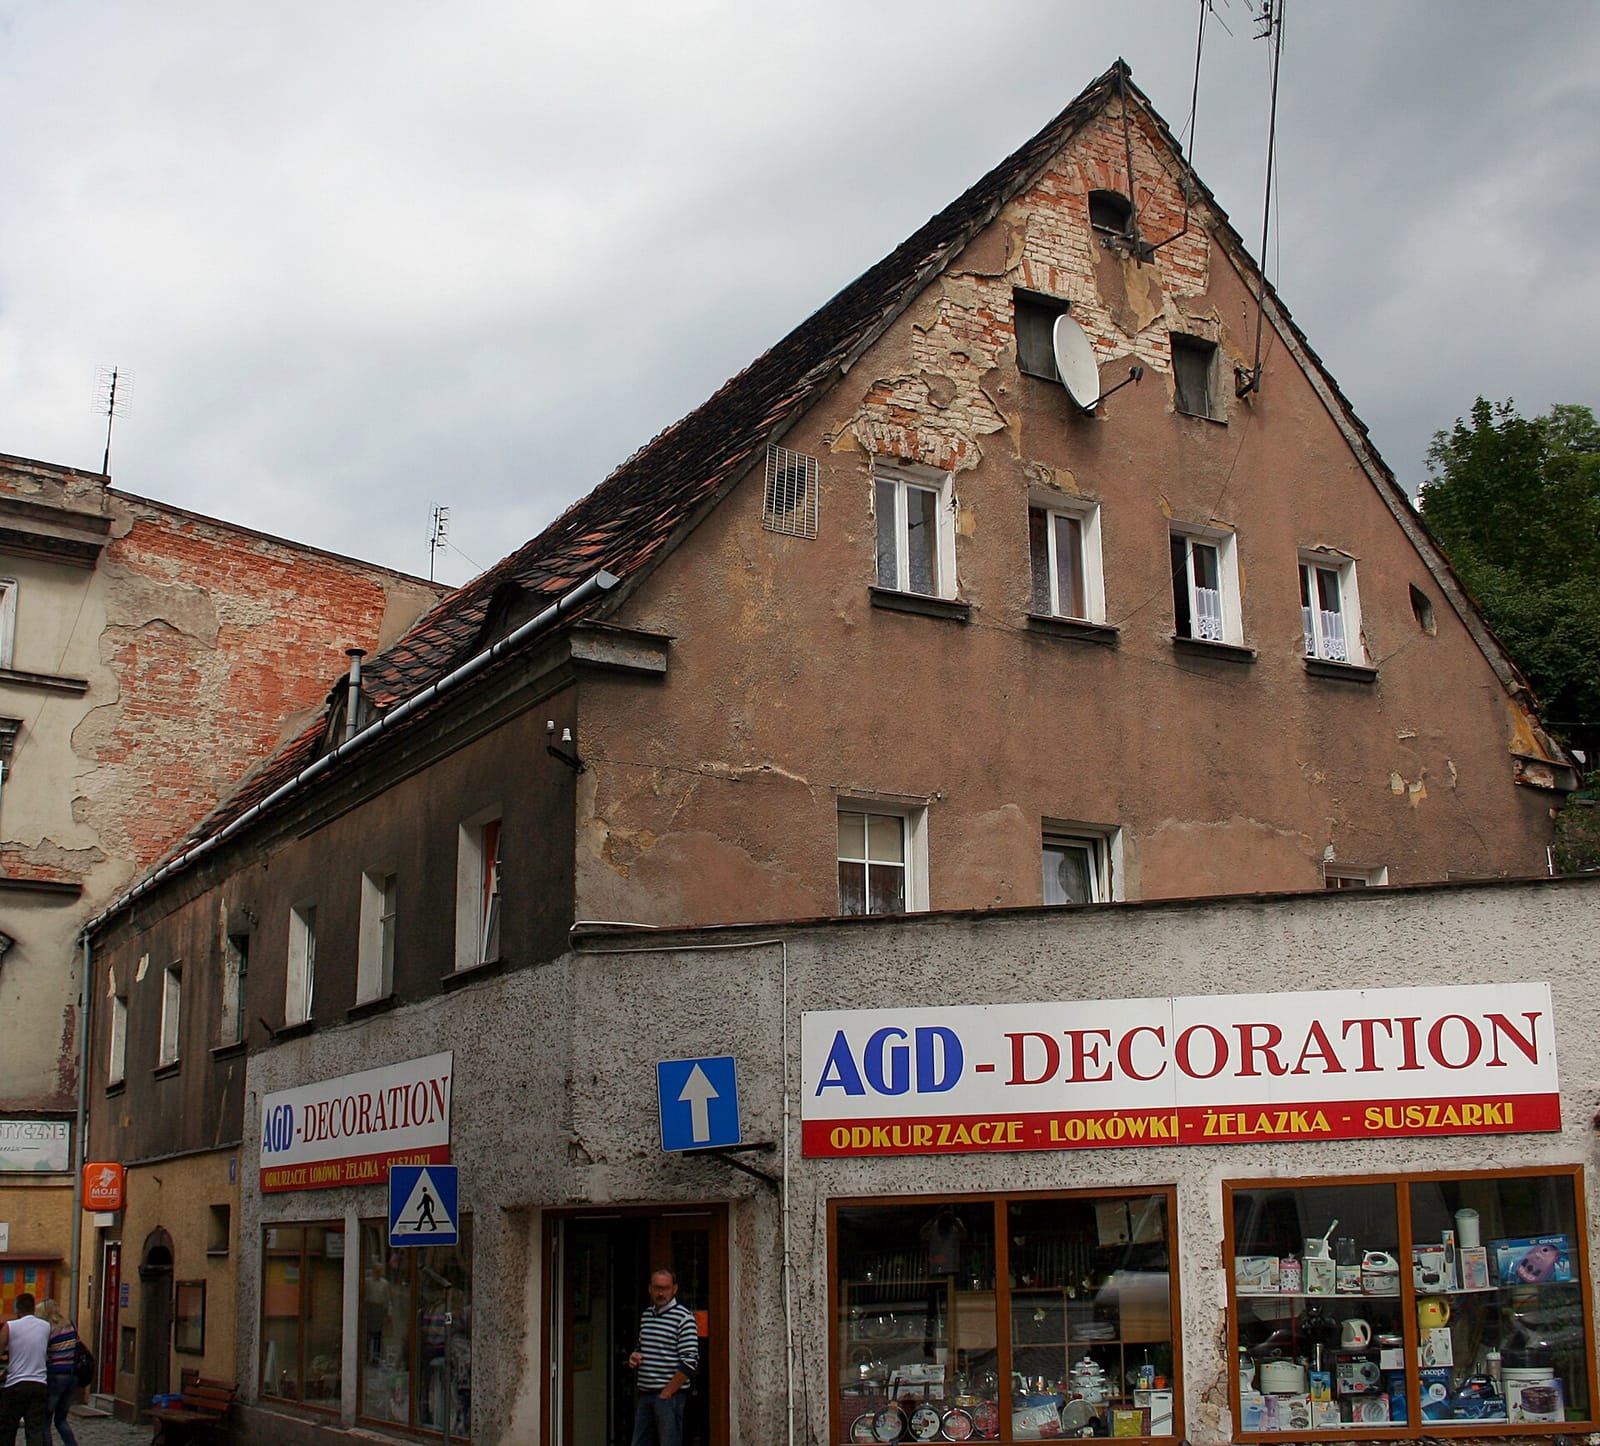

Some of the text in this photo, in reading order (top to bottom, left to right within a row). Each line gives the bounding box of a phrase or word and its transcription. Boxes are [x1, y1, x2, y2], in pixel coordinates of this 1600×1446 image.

[814, 1026, 964, 1097] AGD
[1003, 1012, 1543, 1087] DECORATION
[262, 1104, 294, 1153] AGD
[303, 1076, 449, 1143] DECORATION
[0, 1123, 65, 1139] TYCZNE
[830, 1120, 1024, 1149] ODKURZACZE
[1049, 1111, 1179, 1142] LOKÓWKI
[1202, 1108, 1331, 1137] ŻELAZKA
[1364, 1102, 1514, 1130] SUSZARKI
[345, 1160, 380, 1179] ŻELAZKA
[91, 1187, 119, 1195] MOJE
[1420, 1368, 1446, 1377] oncept
